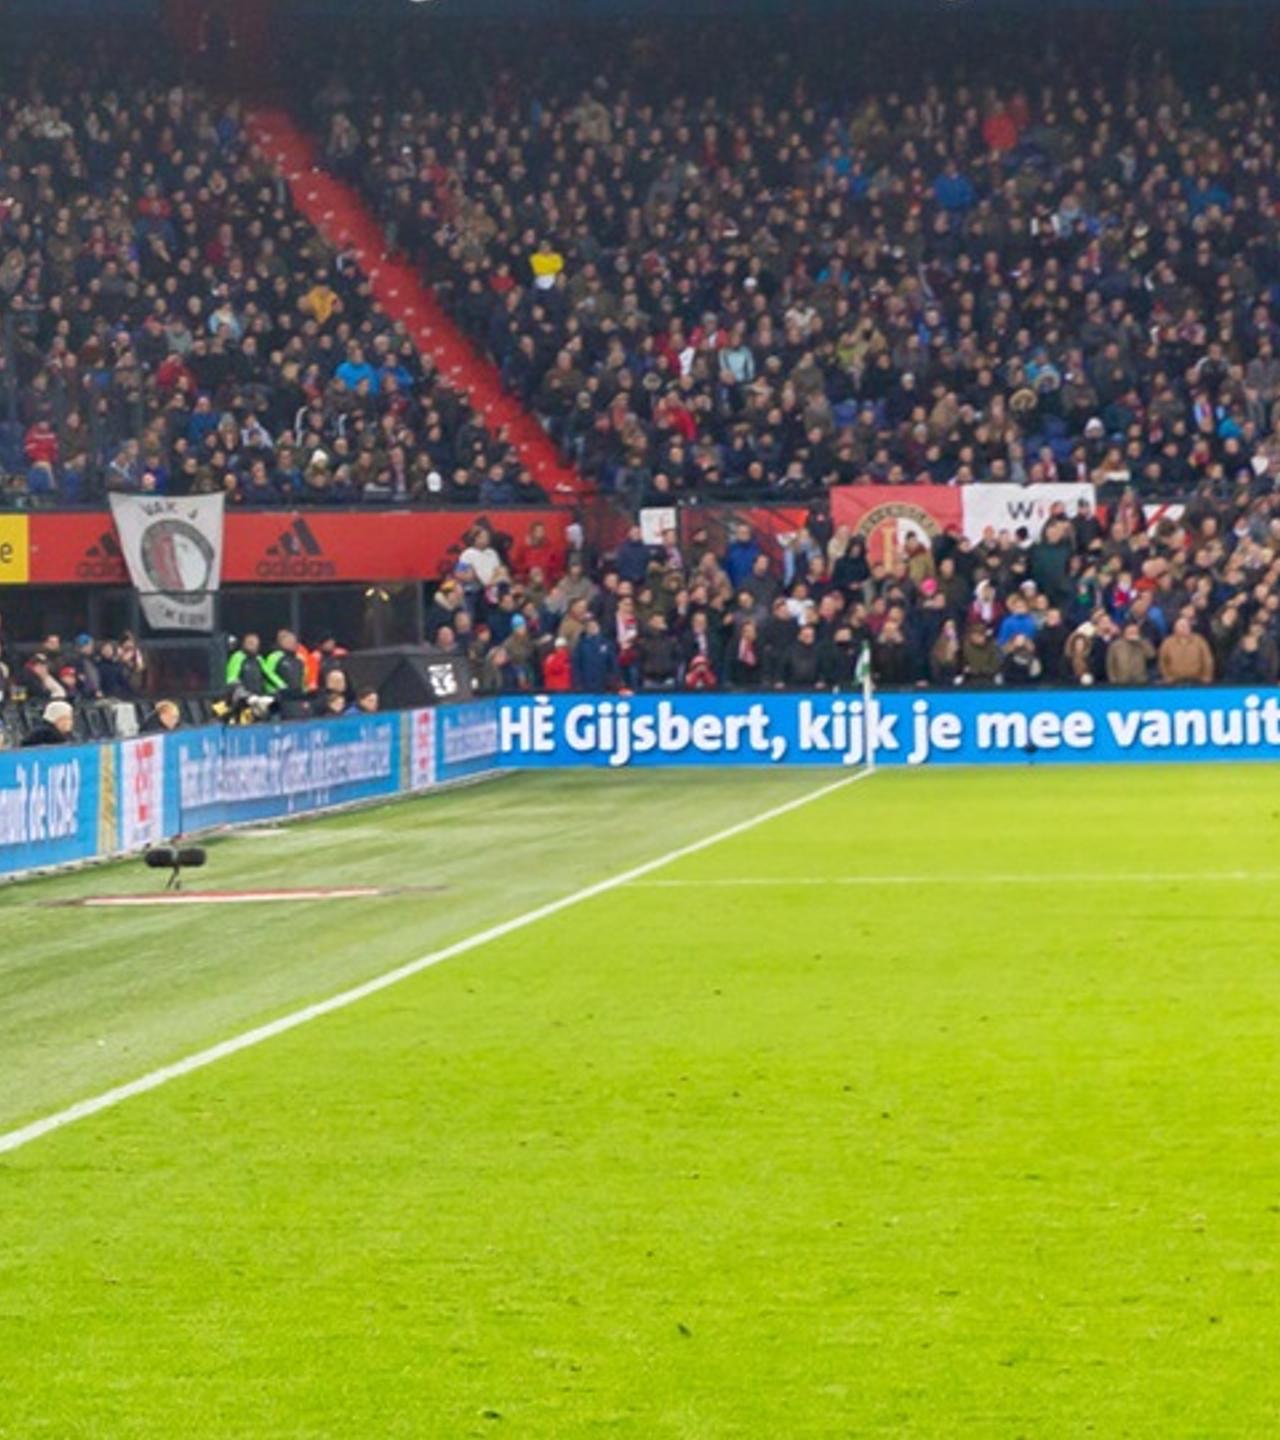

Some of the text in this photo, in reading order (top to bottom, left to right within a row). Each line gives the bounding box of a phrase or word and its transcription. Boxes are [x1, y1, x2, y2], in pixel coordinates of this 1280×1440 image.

[256, 558, 336, 578] adidas
[564, 701, 787, 766] Gijsbert,
[798, 701, 901, 766] kijk
[908, 700, 962, 765] je
[976, 710, 1095, 750] mee
[1106, 695, 1280, 750] vanuit
